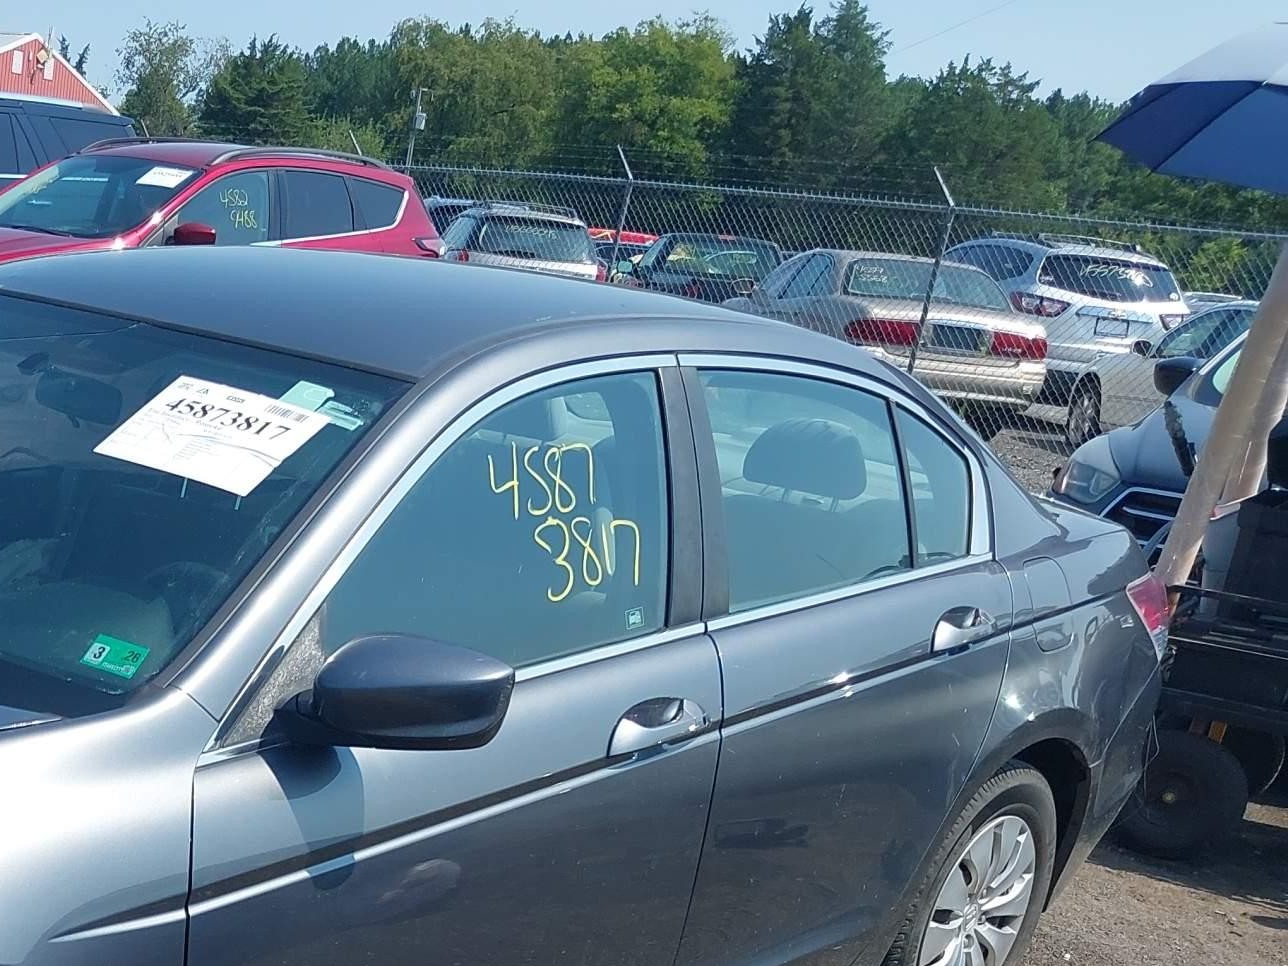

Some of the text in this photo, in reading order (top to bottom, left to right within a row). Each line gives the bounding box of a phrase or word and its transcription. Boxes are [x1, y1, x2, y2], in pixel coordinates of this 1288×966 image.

[219, 188, 249, 209] 4582
[164, 397, 292, 442] 45873817
[487, 440, 597, 521] 4587
[533, 515, 641, 602] 3817
[92, 646, 106, 660] 3
